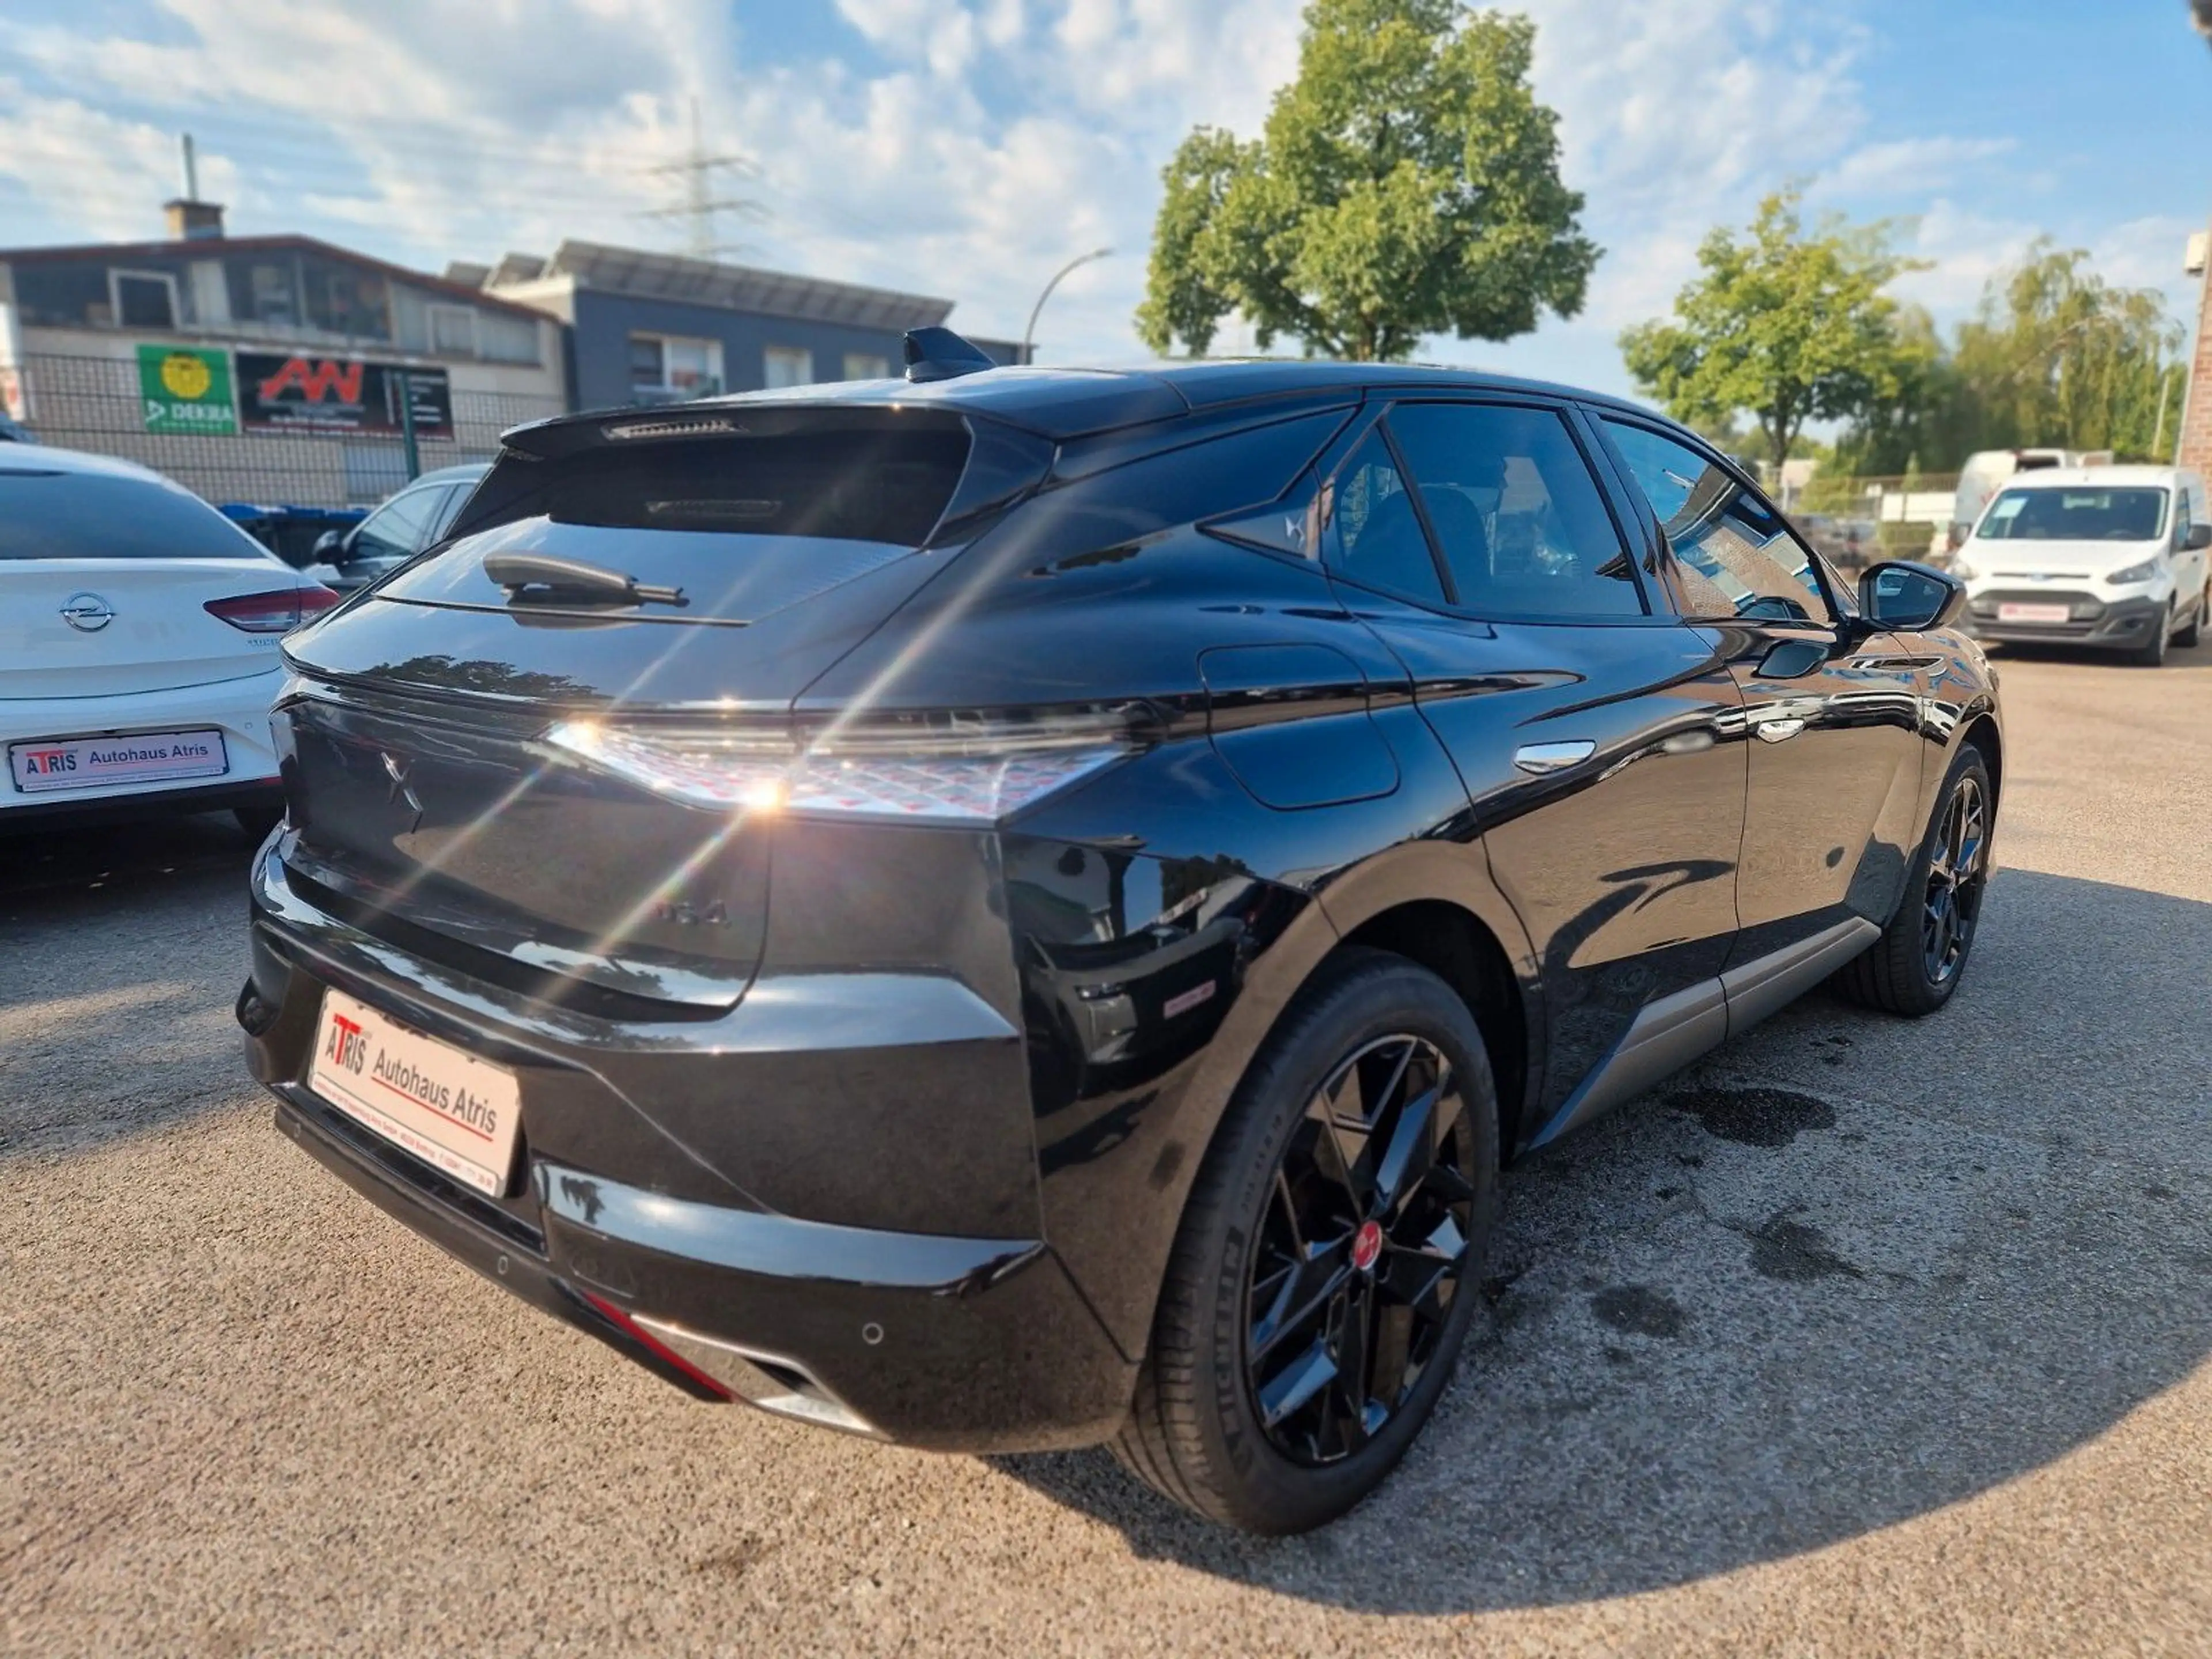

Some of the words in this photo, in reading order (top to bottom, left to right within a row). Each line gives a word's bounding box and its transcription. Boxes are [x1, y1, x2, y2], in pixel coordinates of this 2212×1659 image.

[26, 749, 77, 774] ATRIS
[89, 748, 167, 764] Autohaus
[172, 744, 209, 758] Atris
[325, 1013, 366, 1076] ATRIS
[373, 1048, 450, 1109] Autohaus
[452, 1089, 497, 1134] Atris
[1215, 1242, 1240, 1434] MICHELIN
